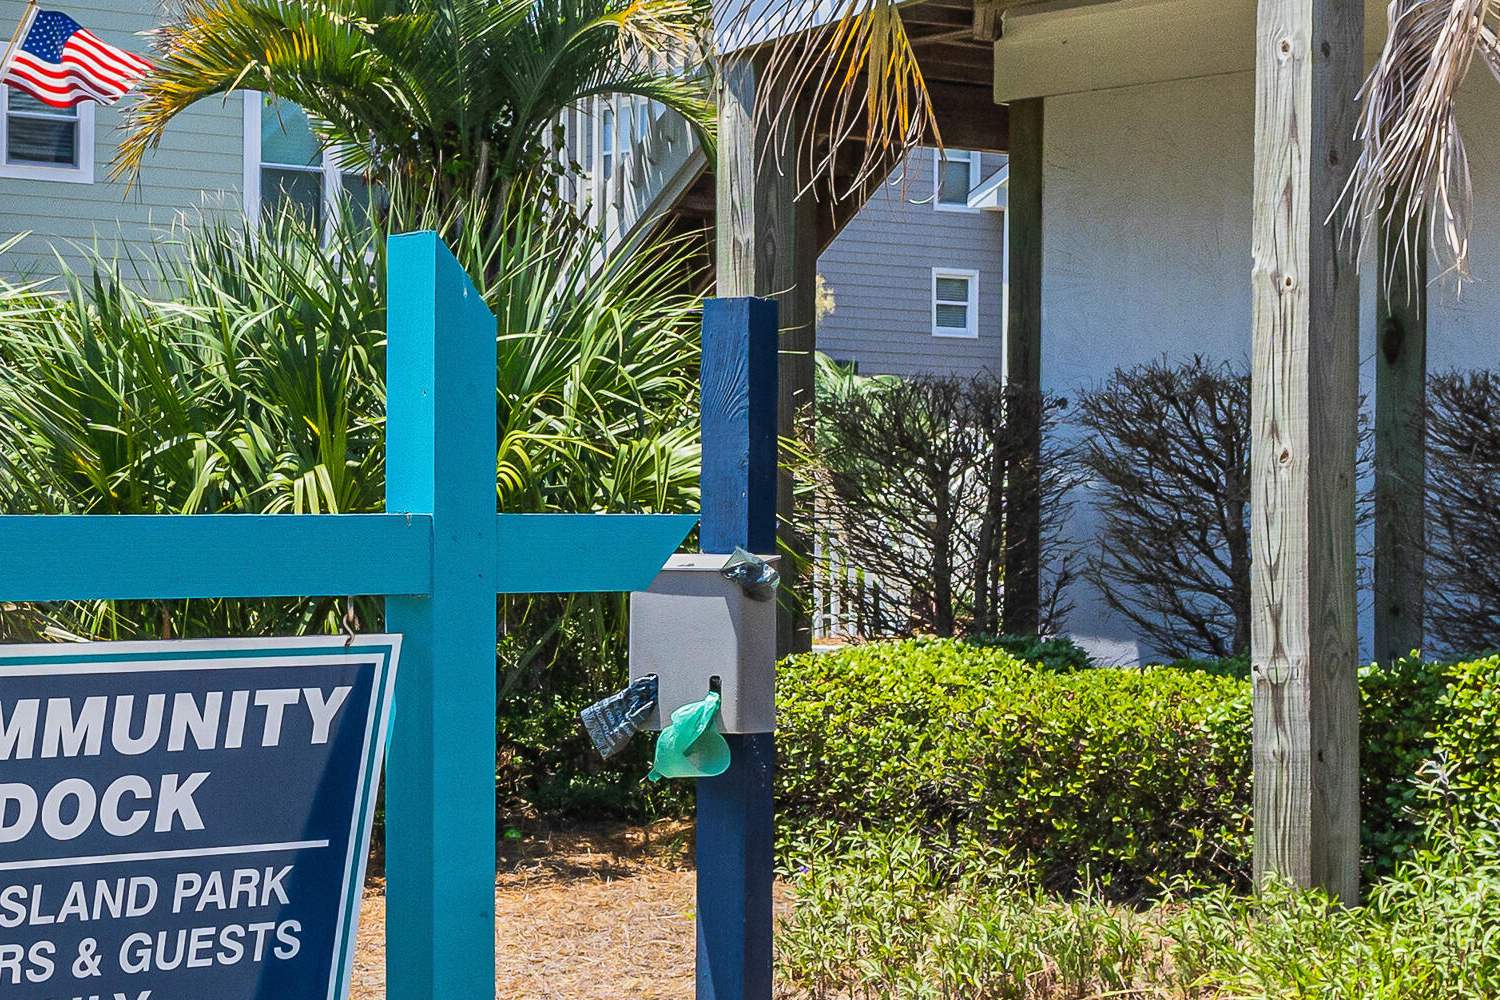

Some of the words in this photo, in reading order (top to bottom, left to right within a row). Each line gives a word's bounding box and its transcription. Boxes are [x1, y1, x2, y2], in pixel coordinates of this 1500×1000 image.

[171, 864, 294, 914] PARK
[71, 937, 103, 979] &
[118, 919, 302, 974] GUESTS
